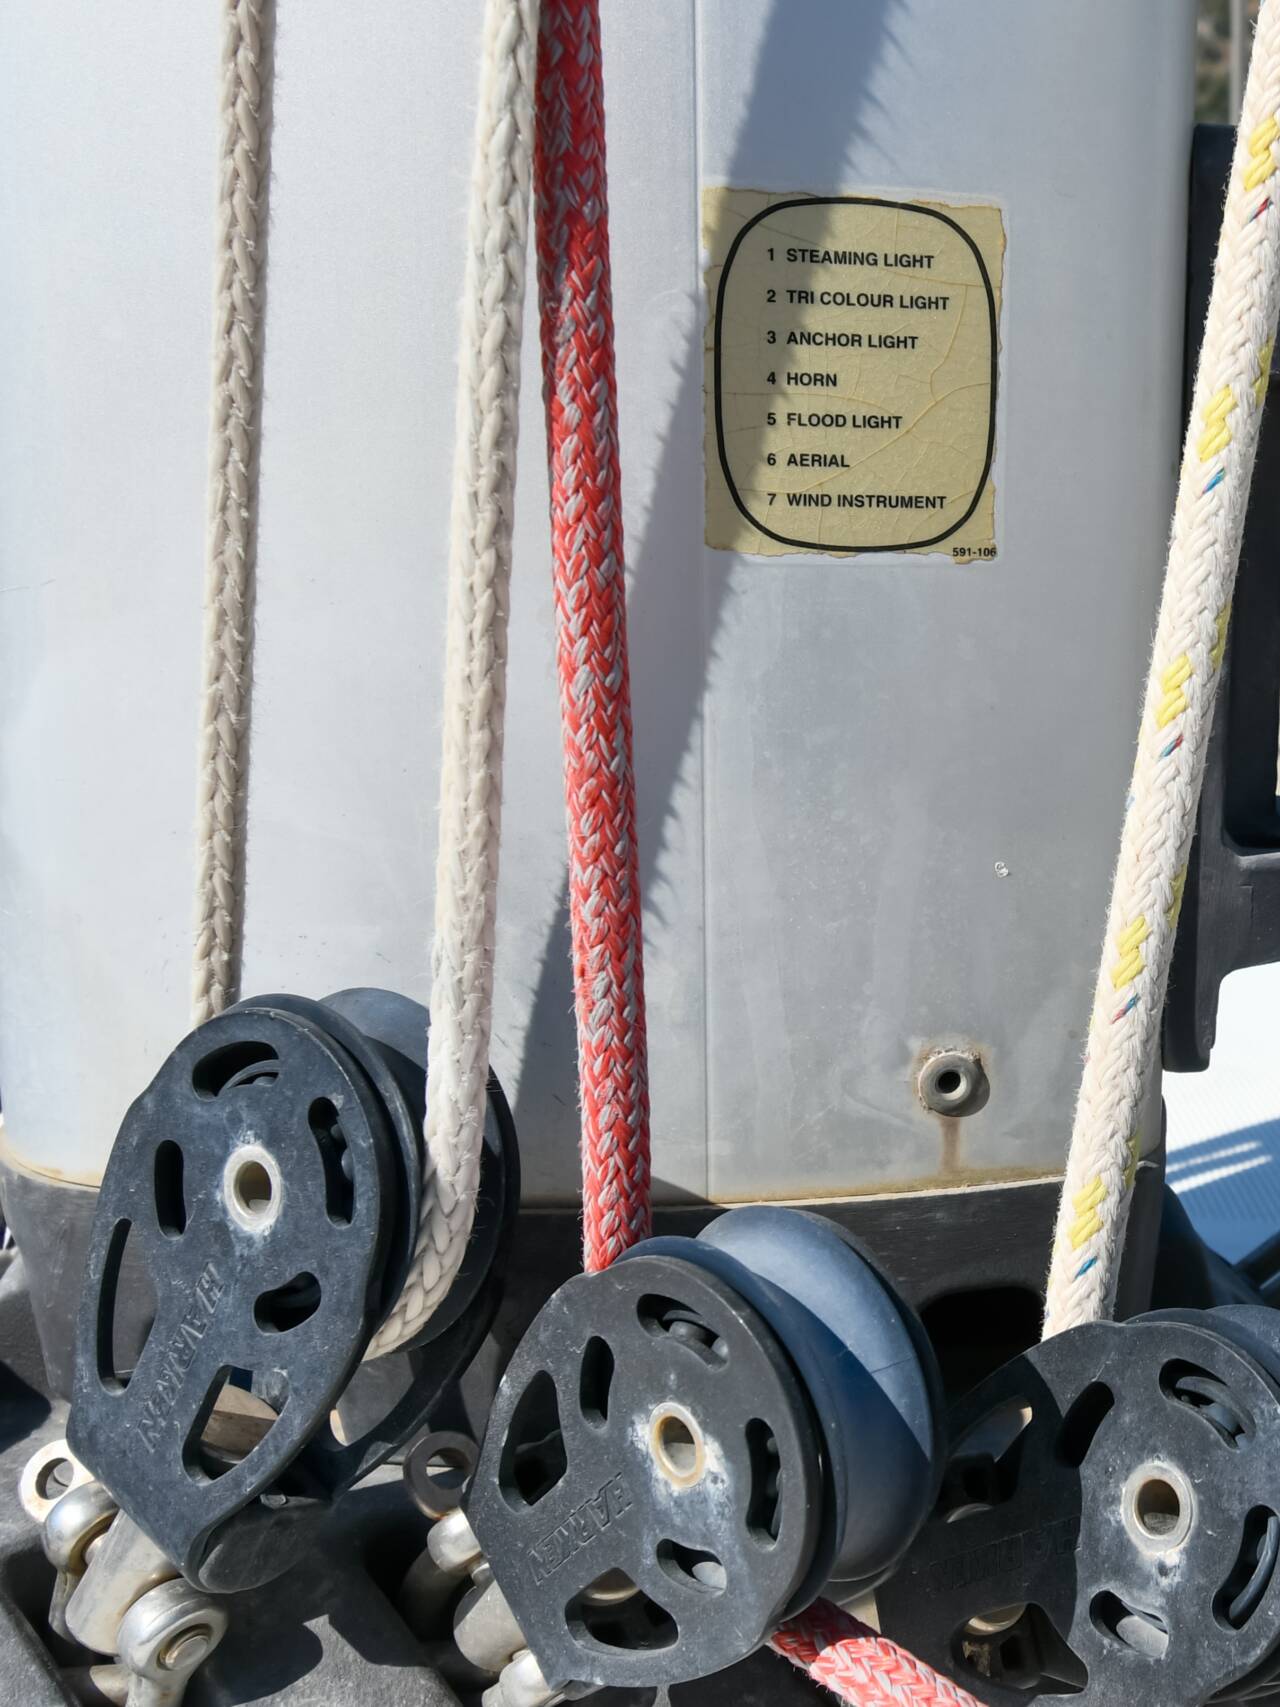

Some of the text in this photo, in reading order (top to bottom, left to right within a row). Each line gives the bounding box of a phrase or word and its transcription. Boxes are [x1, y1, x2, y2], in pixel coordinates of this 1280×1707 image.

[767, 247, 935, 269] 1 STEAMING LIGHT
[767, 289, 949, 310] 2 TRI COLOUR LIGHT
[767, 330, 919, 350] 3 ANCHOR LIGHT
[767, 371, 837, 387] 4 HORN
[767, 412, 902, 429] 5 FLOOD LIGHT
[767, 452, 850, 468] 6 AERIAL
[767, 493, 947, 509] 7 WIND INSTRUMENT
[952, 546, 997, 558] 591-106
